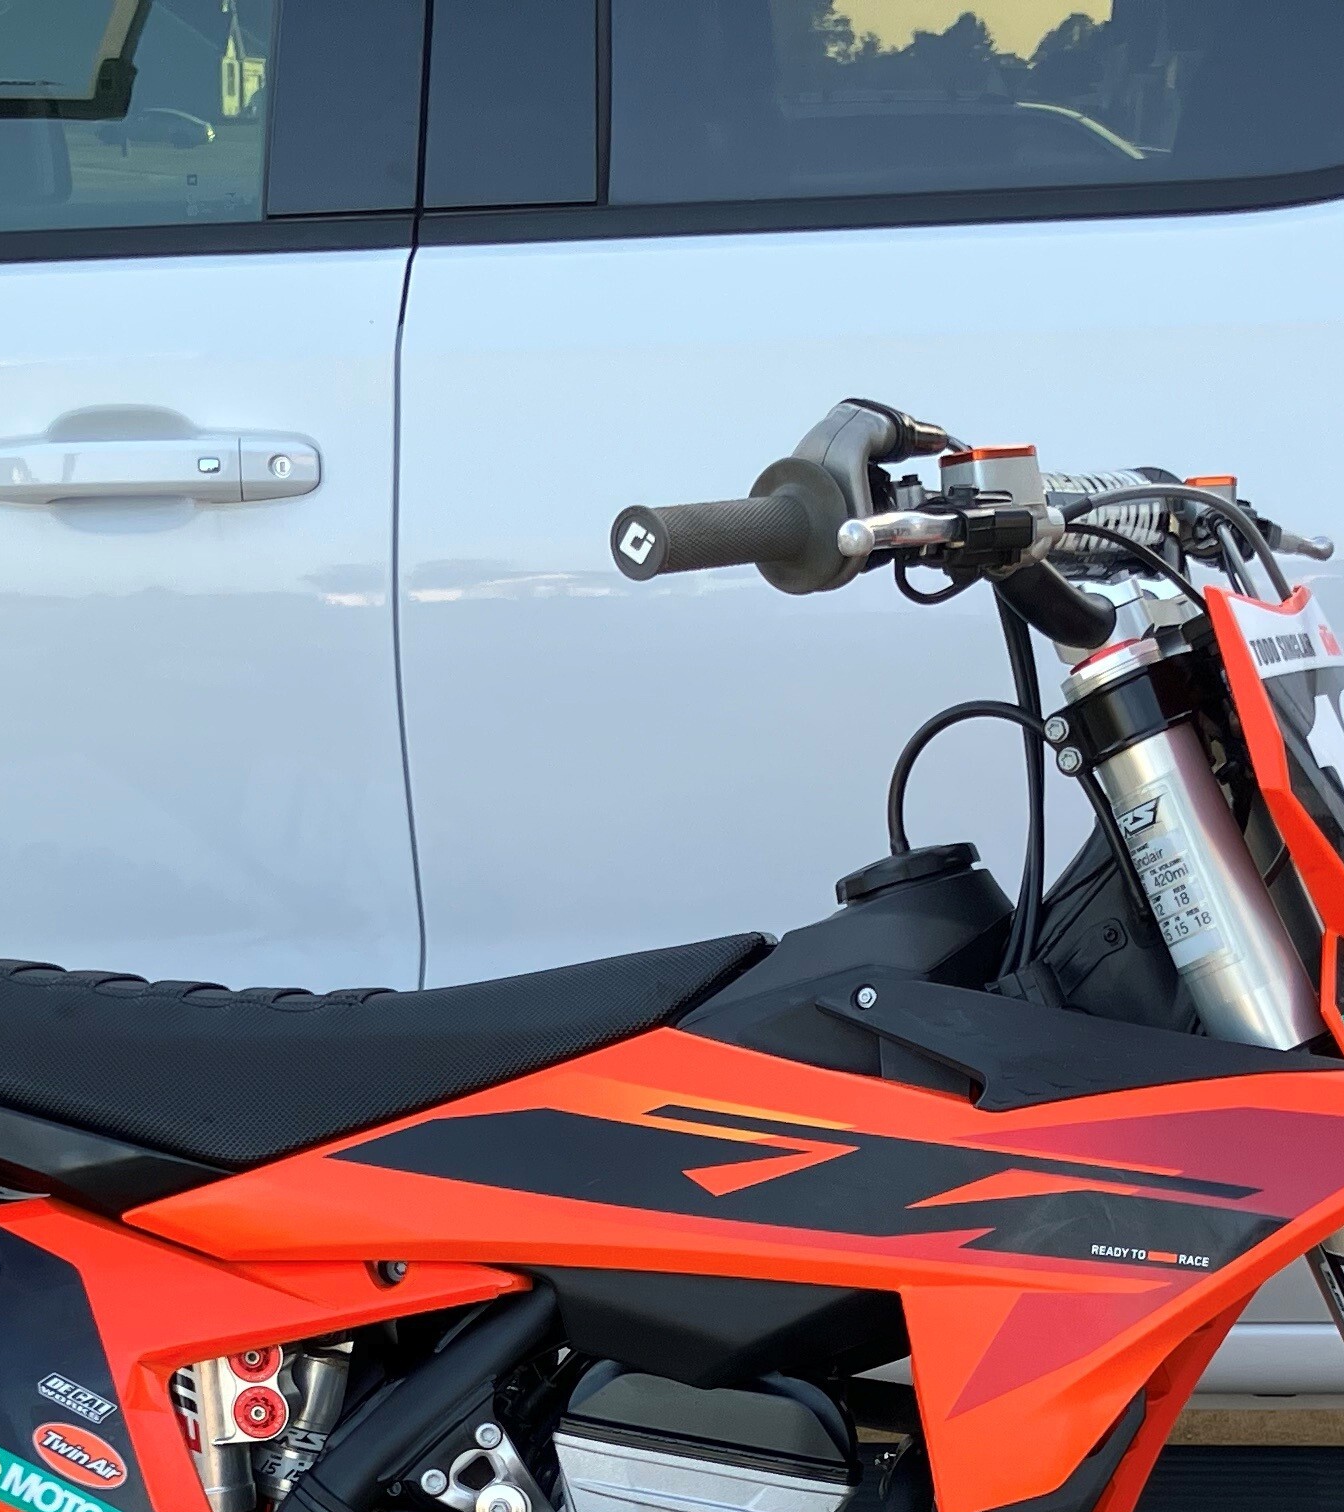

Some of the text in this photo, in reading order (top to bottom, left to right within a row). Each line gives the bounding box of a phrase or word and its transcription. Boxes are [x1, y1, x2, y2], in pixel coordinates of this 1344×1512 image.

[1117, 798, 1158, 838] RS
[1154, 863, 1189, 888] 420ml
[1174, 892, 1190, 907] 18
[1174, 921, 1189, 936] 15
[1194, 911, 1212, 927] 18
[1091, 1244, 1209, 1267] READY TO RACE
[45, 1375, 111, 1415] DECAL
[40, 1430, 123, 1481] Twin Air
